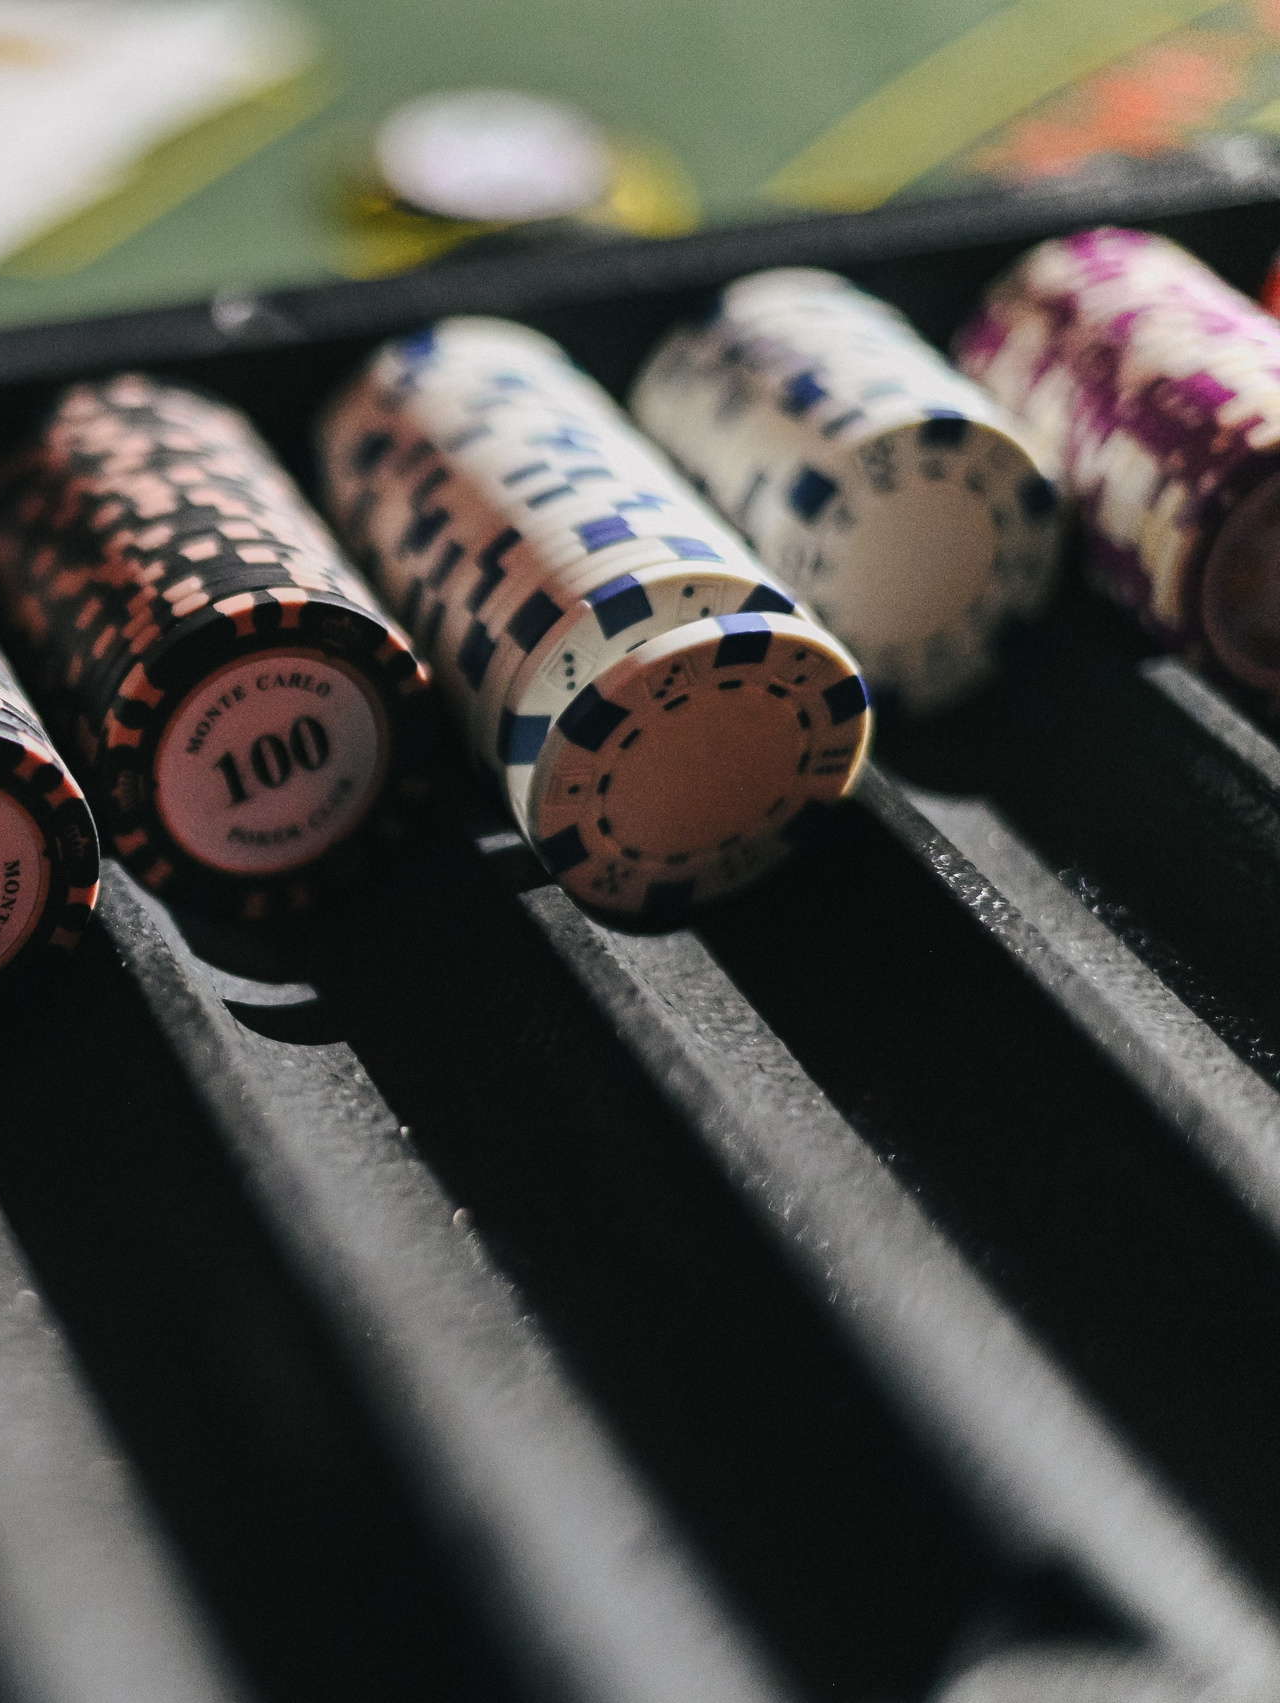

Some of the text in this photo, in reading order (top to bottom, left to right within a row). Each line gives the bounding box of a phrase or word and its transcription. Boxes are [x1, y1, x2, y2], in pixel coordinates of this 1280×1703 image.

[185, 672, 332, 755] MONTE CARLO
[213, 715, 330, 808] 100
